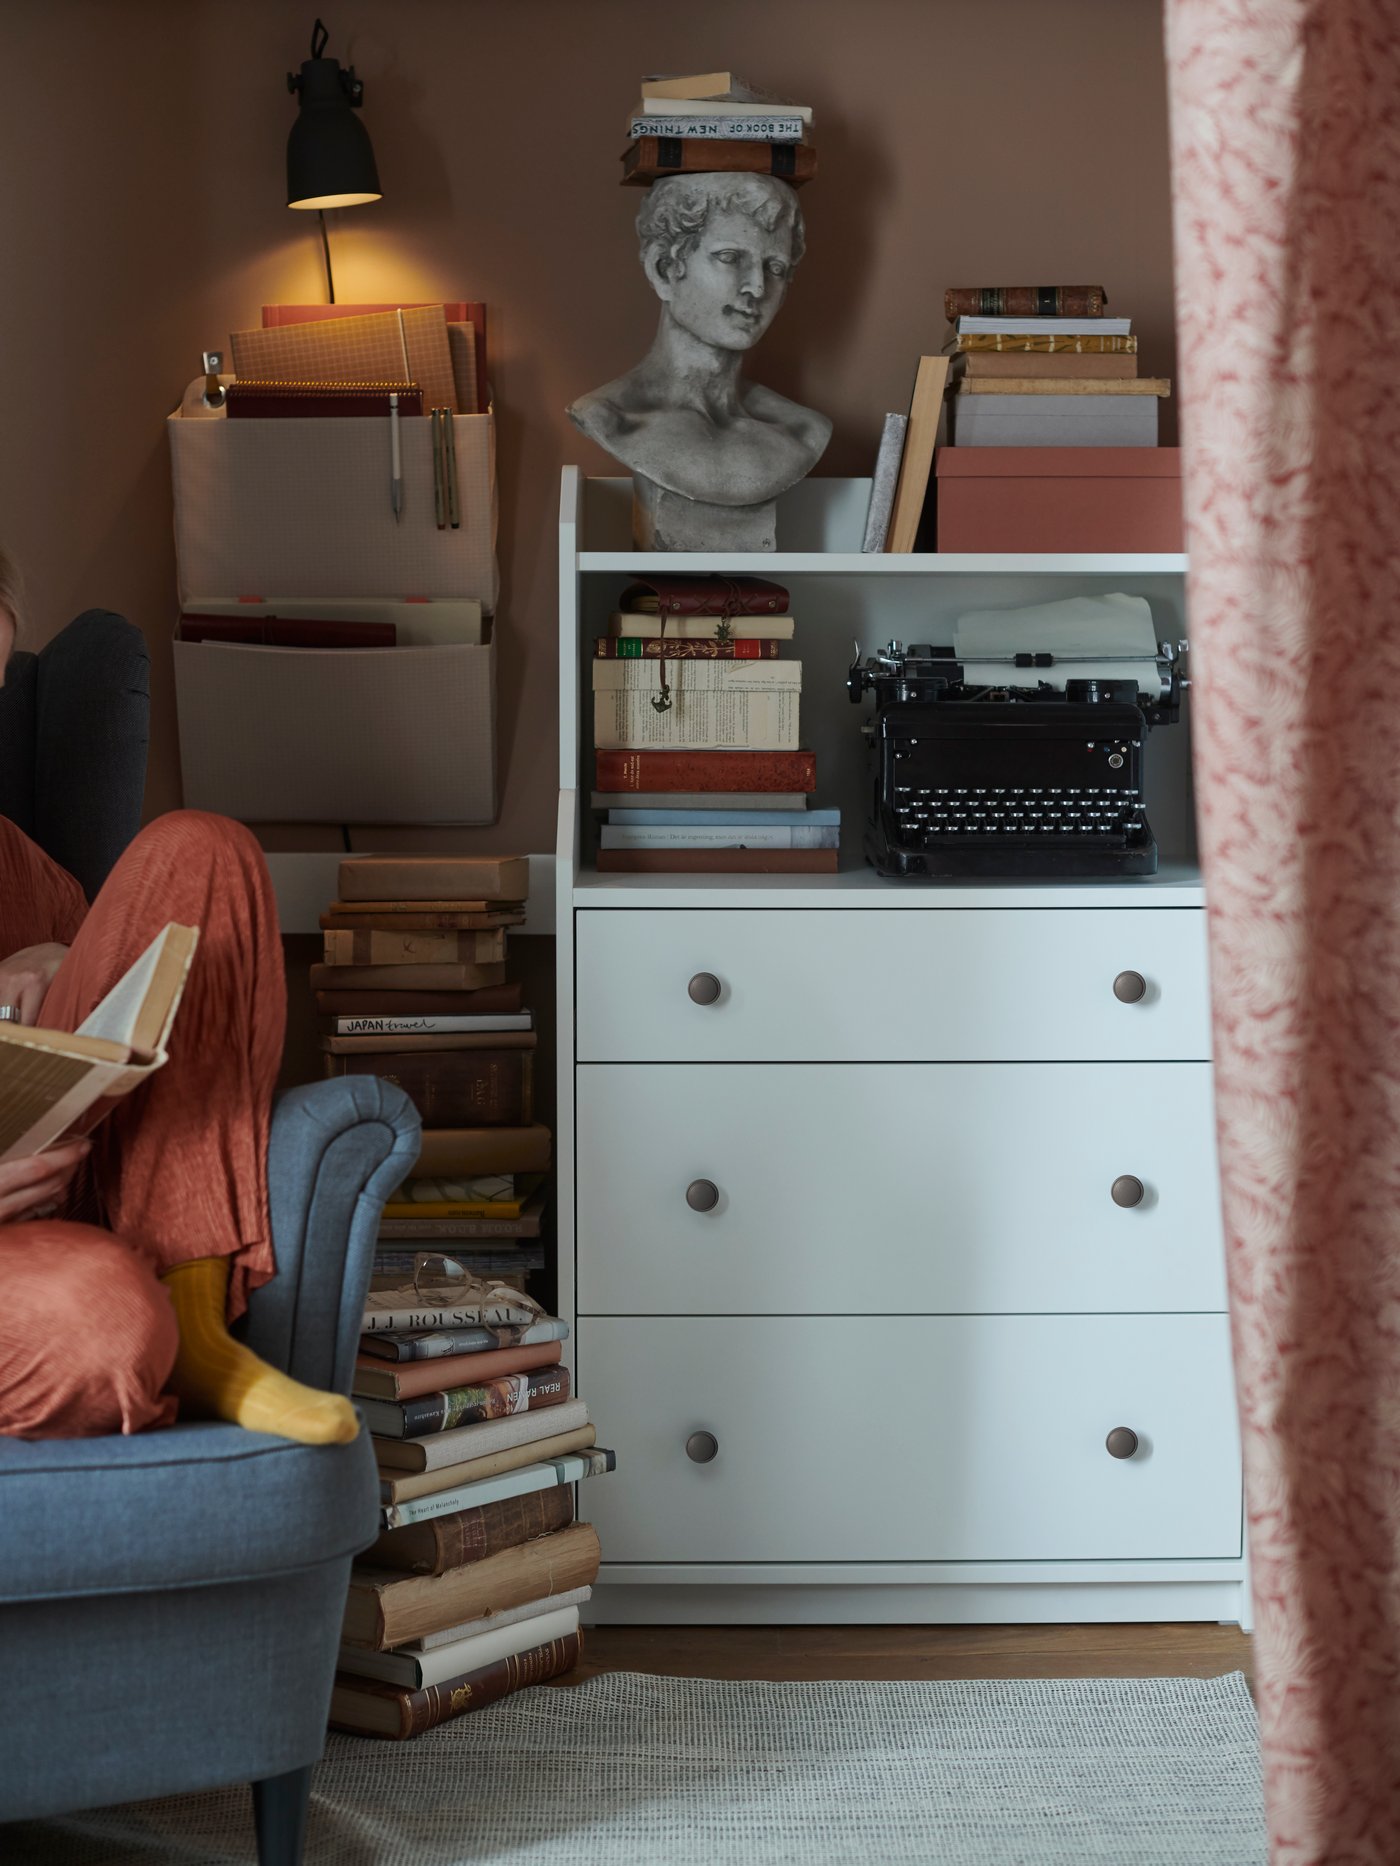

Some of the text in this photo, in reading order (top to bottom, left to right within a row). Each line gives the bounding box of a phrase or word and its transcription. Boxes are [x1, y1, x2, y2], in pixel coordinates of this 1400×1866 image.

[632, 123, 799, 135] THE BOOK OF NEW THINGS
[347, 1019, 435, 1032] JAPAN travel
[507, 1382, 561, 1402] REAL RAEN
